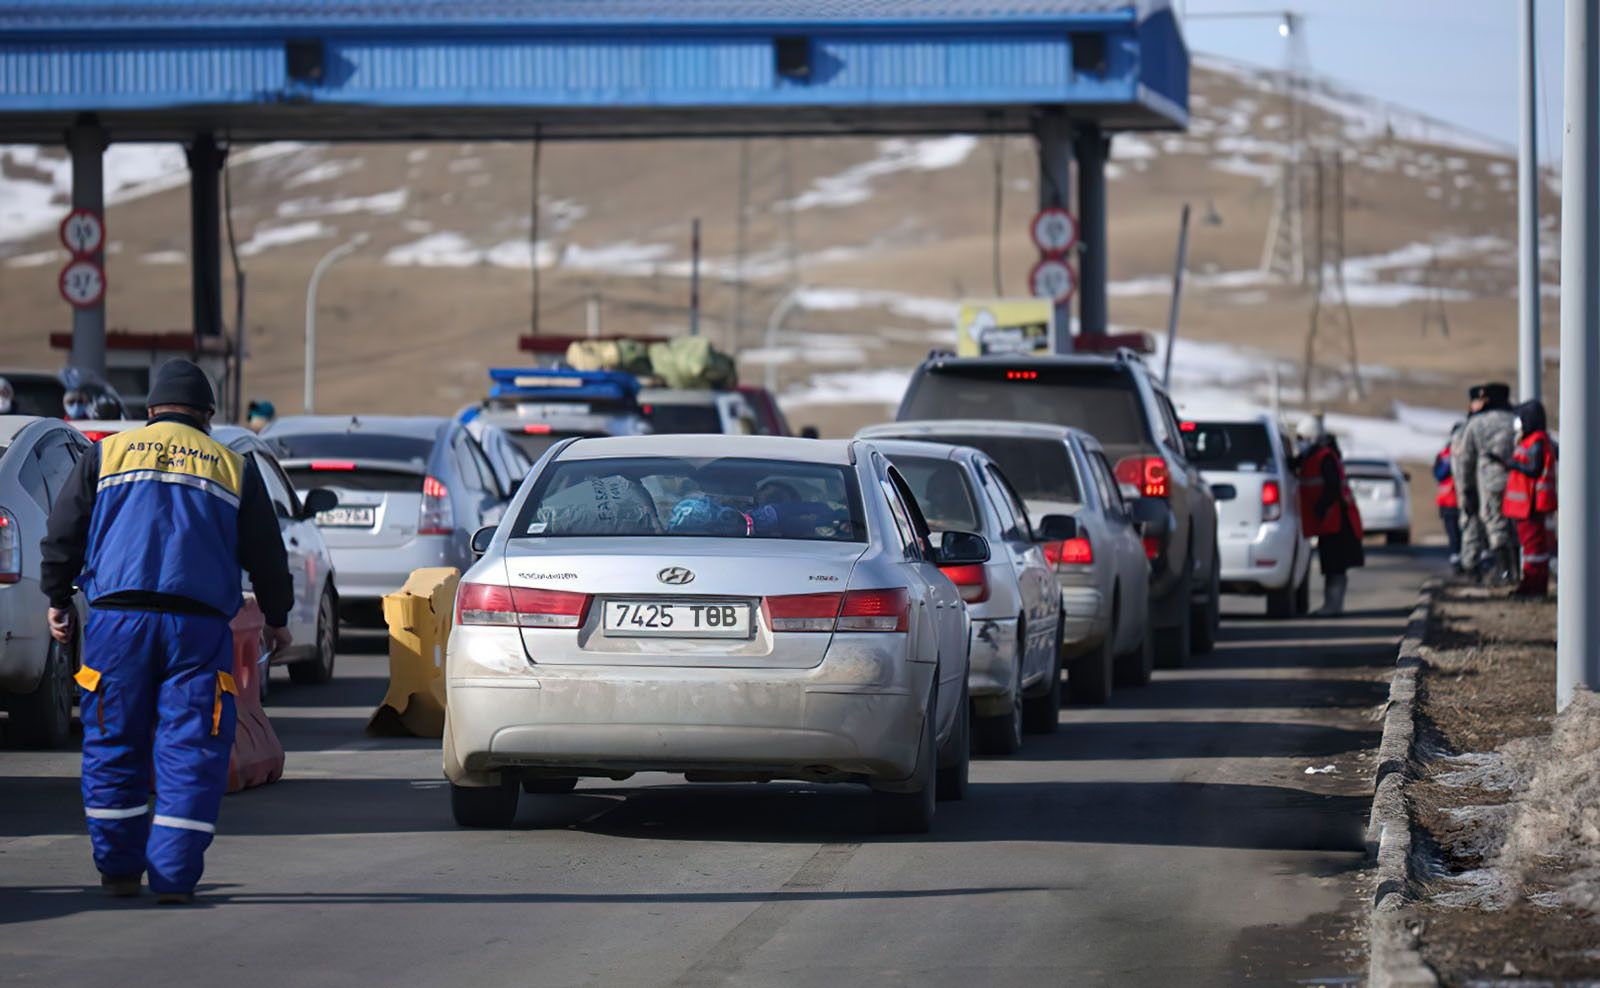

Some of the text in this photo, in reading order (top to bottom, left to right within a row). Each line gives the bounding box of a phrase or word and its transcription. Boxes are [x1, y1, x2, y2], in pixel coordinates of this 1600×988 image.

[127, 442, 164, 452] АВТО
[616, 604, 737, 628] 7425 ТӨВ
